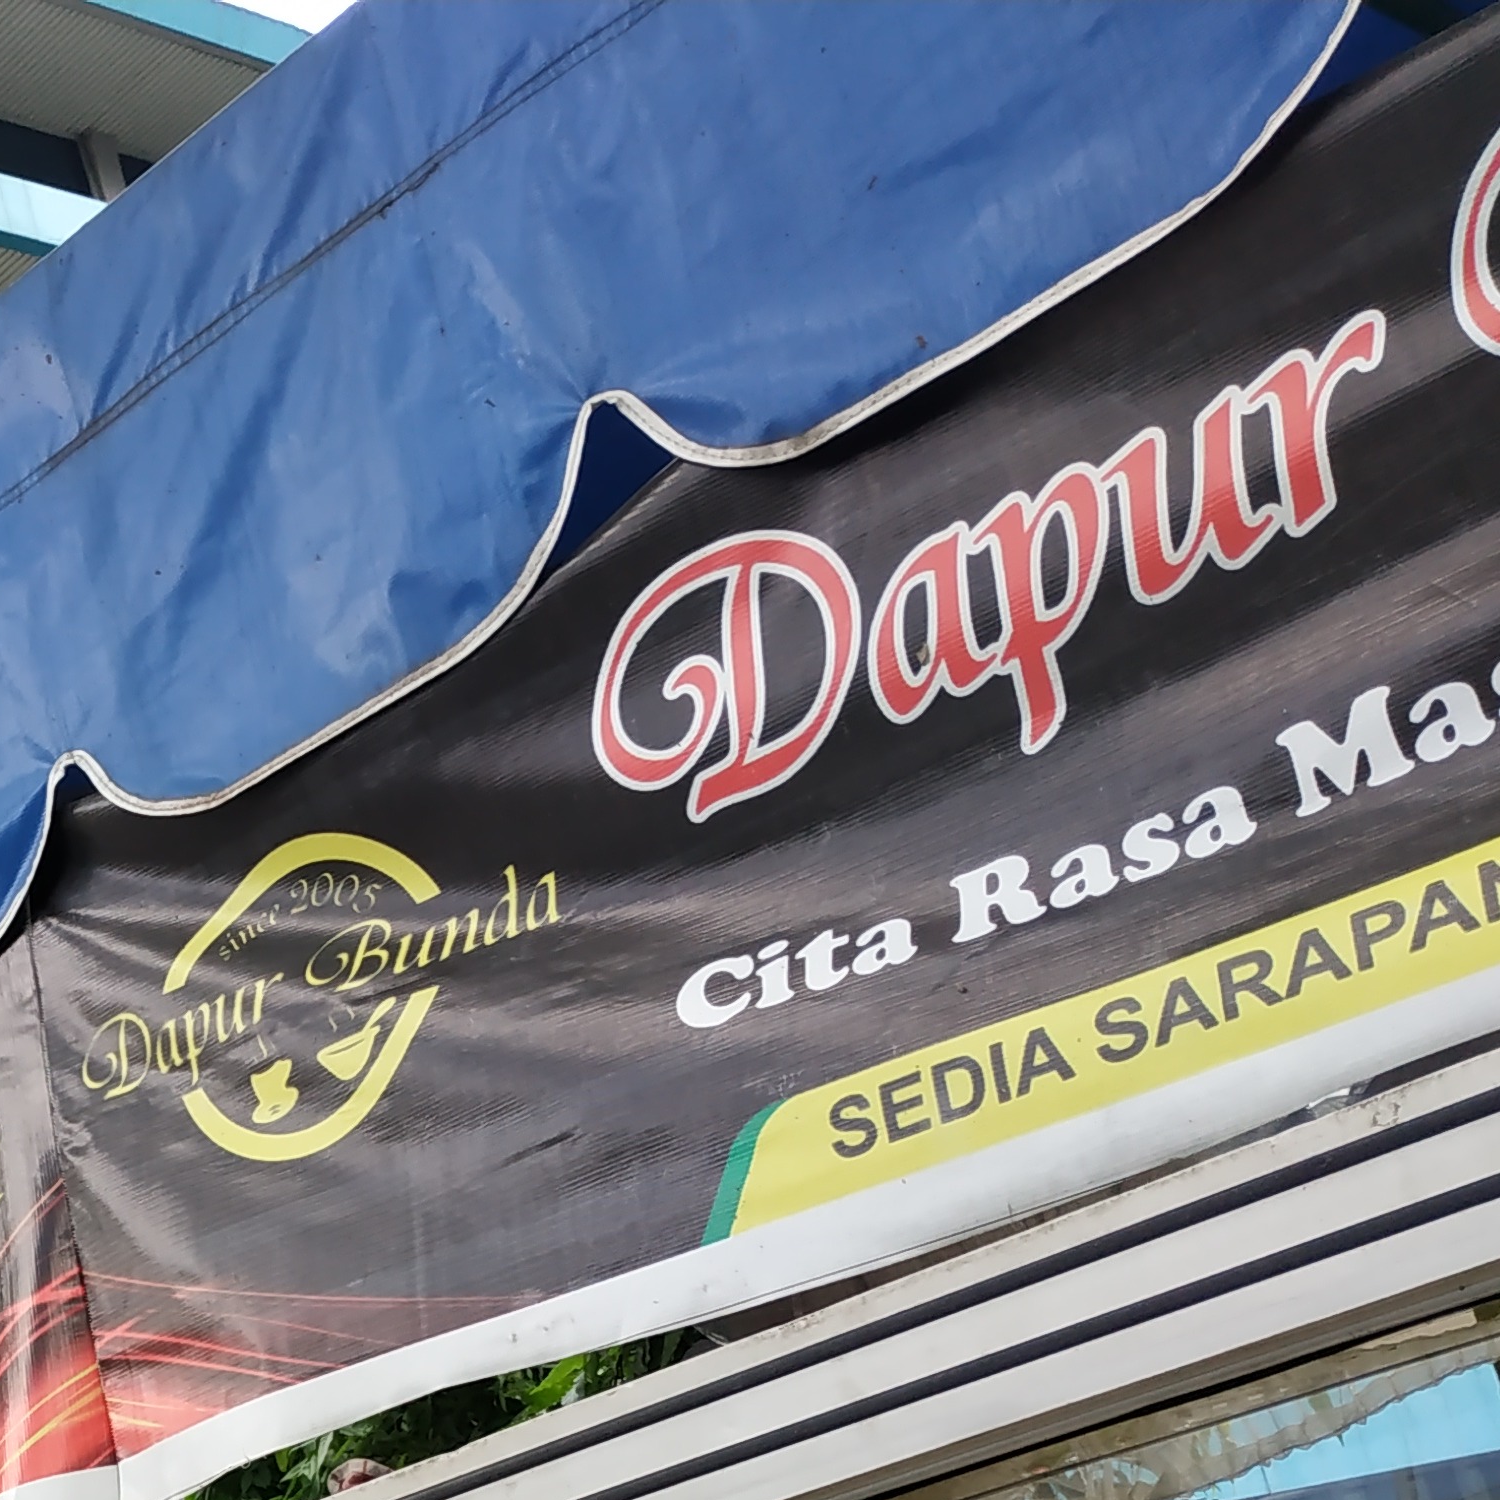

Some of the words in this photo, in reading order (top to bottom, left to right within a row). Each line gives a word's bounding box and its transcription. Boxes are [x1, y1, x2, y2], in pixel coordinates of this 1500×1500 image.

[592, 309, 1386, 822] Dapur
[218, 902, 280, 961] since
[290, 872, 381, 916] 2005
[675, 917, 916, 1028] Cita
[950, 786, 1256, 943] Rasa
[1276, 662, 1500, 816] Ma
[81, 972, 284, 1100] Dapur
[305, 865, 563, 991] Bunda
[828, 1028, 1075, 1159] SEDIA
